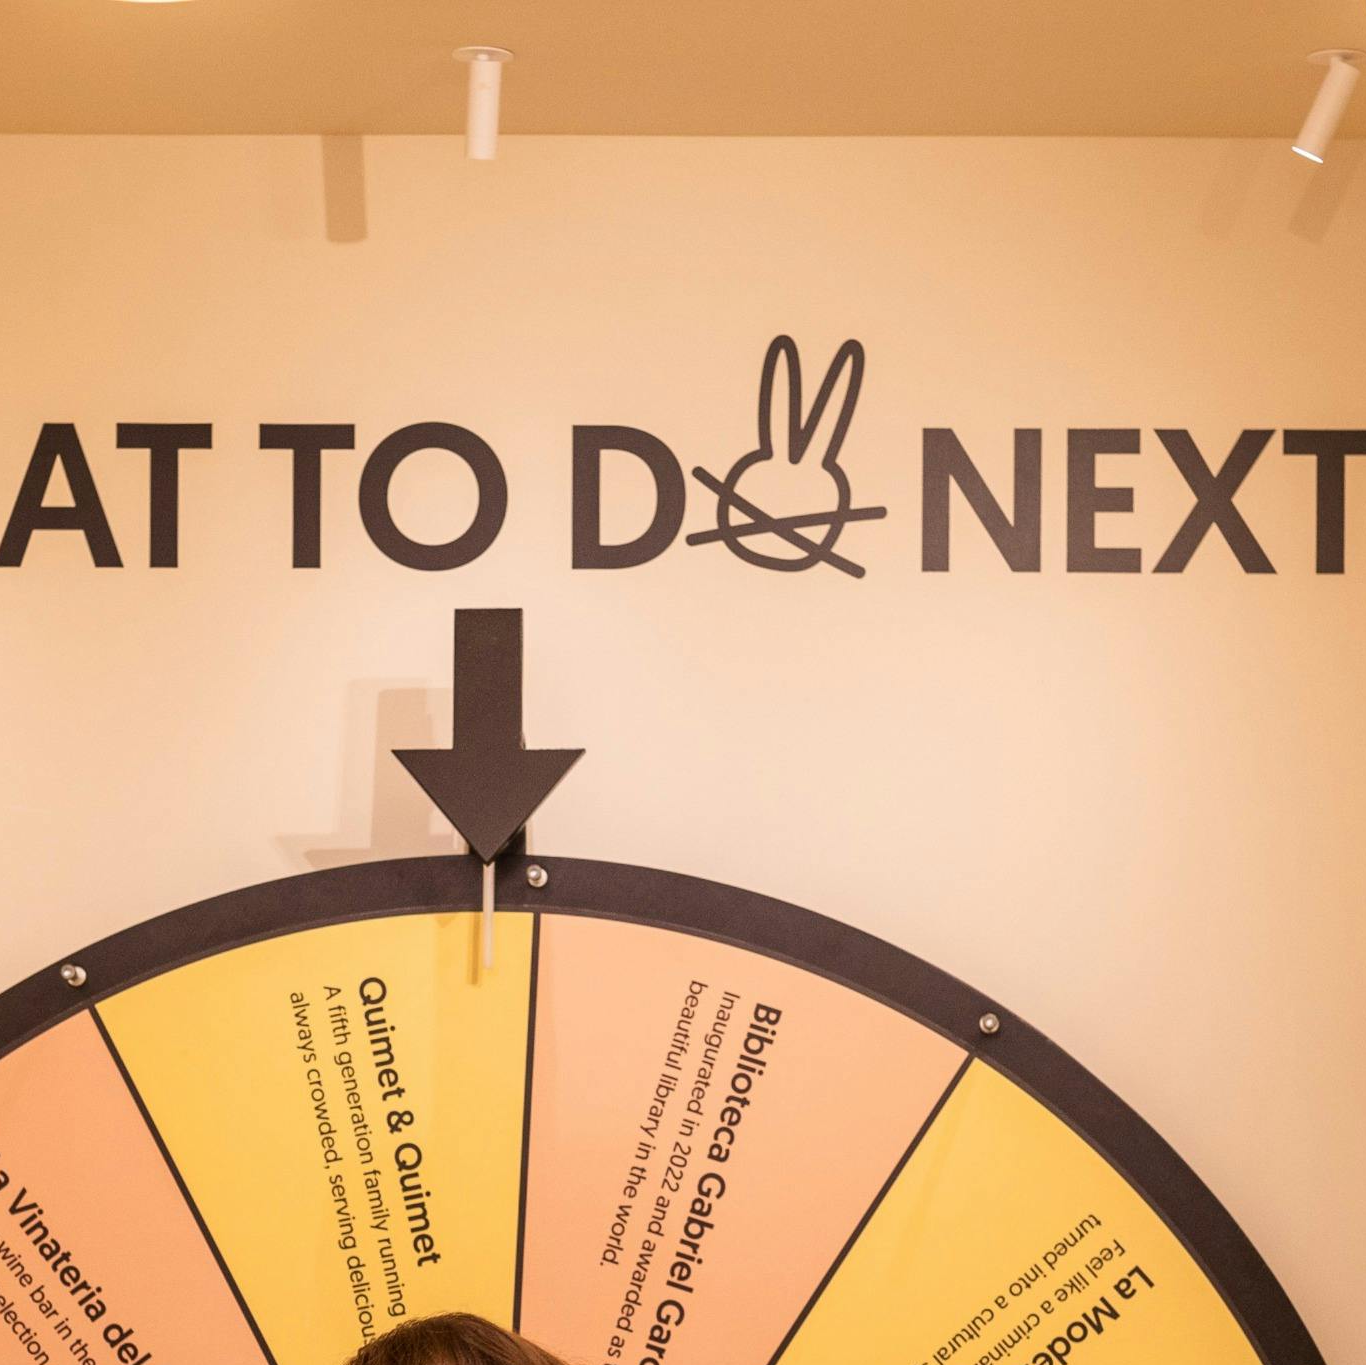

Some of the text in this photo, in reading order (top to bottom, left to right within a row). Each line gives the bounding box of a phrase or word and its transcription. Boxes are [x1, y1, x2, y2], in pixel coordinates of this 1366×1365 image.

[258, 419, 509, 572] TO
[686, 991, 741, 1116] Inaugurated
[706, 1002, 783, 1164] Biblioteca
[289, 992, 317, 1064] always
[306, 1068, 343, 1170] crowded,
[328, 1174, 357, 1251] serving
[358, 976, 442, 1268] Quimet & Quimet
[599, 980, 709, 1266] beautiful library in the world.
[678, 1118, 700, 1137] in
[323, 986, 406, 1317] A fifth generation family running
[661, 1141, 692, 1193] 2022
[646, 1195, 671, 1237] and
[665, 1172, 727, 1294] Gabriel
[1042, 1214, 1102, 1271] turned
[8, 1186, 107, 1323] Vinateria
[1008, 1263, 1044, 1297] into
[1085, 1239, 1126, 1279] Feel
[1113, 1265, 1155, 1300] La
[29, 1284, 59, 1319] bar
[53, 1317, 73, 1341] in
[615, 1239, 657, 1334] awarded
[994, 1295, 1009, 1310] a
[1039, 1300, 1055, 1315] a
[1054, 1271, 1090, 1302] like
[607, 1335, 626, 1359] as
